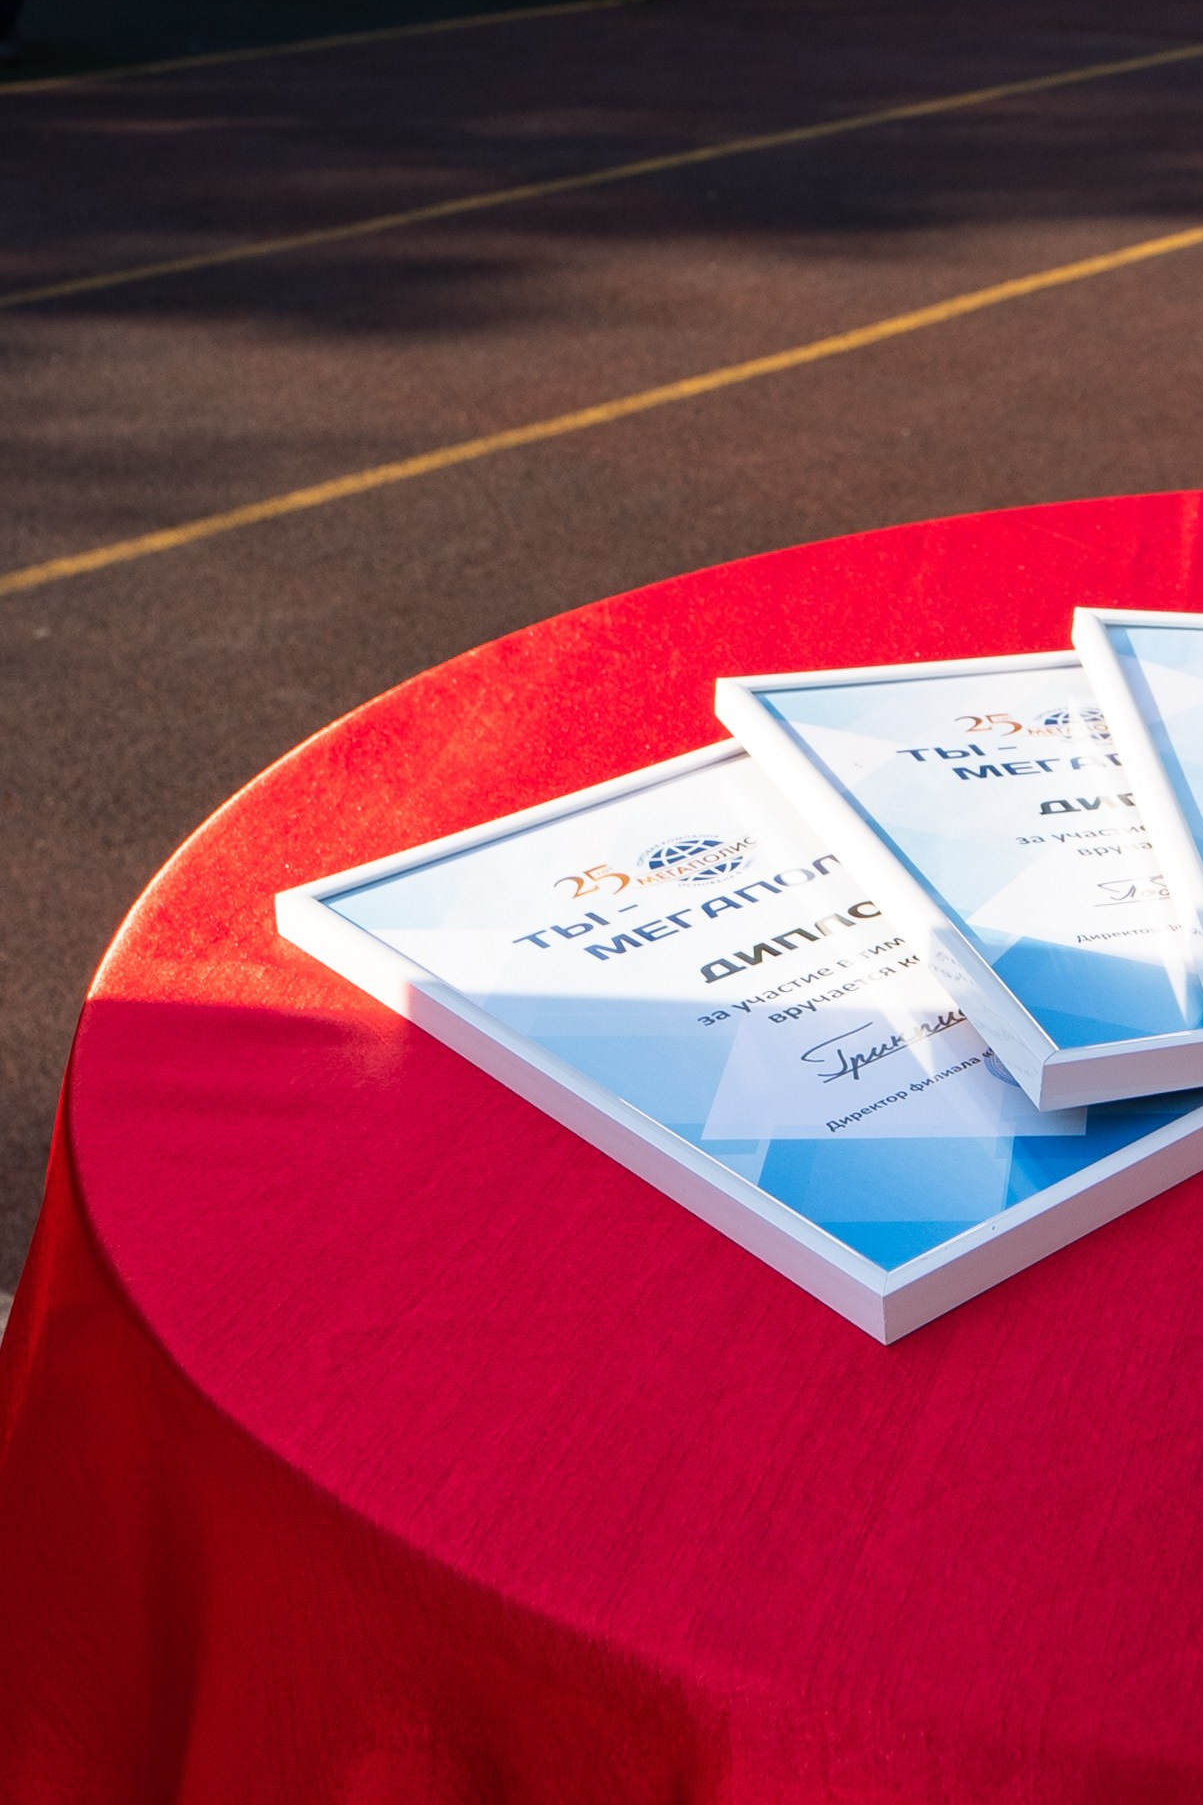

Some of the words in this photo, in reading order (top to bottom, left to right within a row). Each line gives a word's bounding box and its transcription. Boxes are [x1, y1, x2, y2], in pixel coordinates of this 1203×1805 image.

[896, 744, 987, 762] ТЫ
[954, 713, 1023, 737] 25
[553, 864, 631, 899] 25
[636, 836, 758, 886] МЕГАПОЛИС
[1016, 836, 1046, 845] за
[512, 912, 611, 949] ТЫ
[583, 854, 842, 961] МЕГАПОЛ
[700, 900, 882, 983] ДИПЛО
[697, 1009, 731, 1026] за
[731, 967, 833, 1013] участие
[767, 965, 896, 1024] вручается
[825, 1089, 908, 1132] Директор
[909, 1056, 981, 1092] филиала
